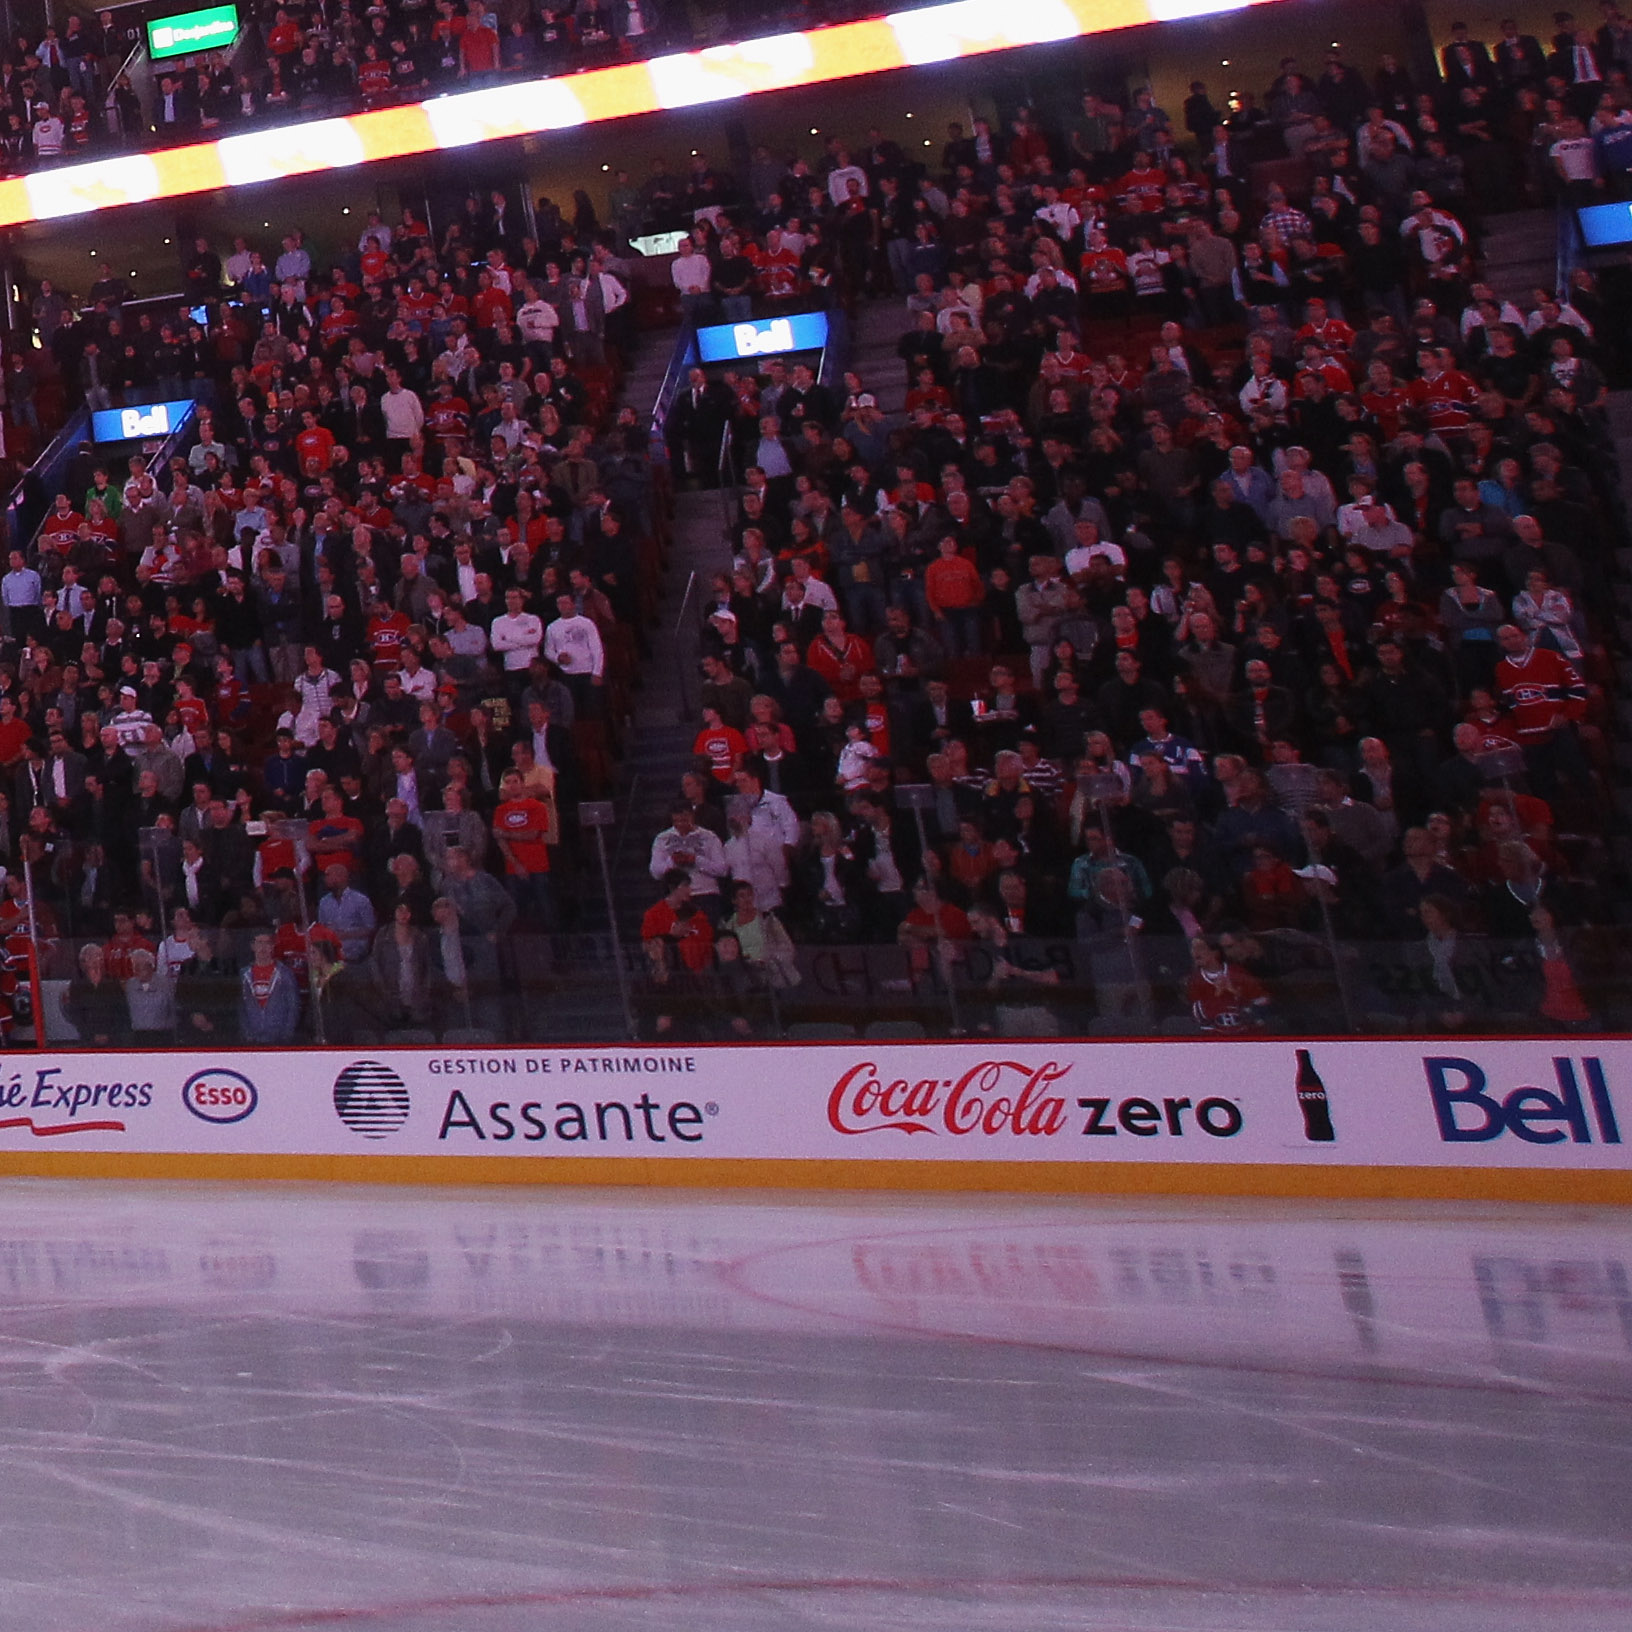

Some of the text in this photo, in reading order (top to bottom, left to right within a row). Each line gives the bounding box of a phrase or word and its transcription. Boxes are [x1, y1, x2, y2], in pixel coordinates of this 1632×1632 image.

[733, 318, 794, 356] Bell
[121, 404, 169, 438] Bell
[428, 1056, 696, 1074] GESTION DE PATRIMOINE
[30, 1068, 153, 1117] Express
[827, 1060, 1244, 1139] Coca-Cola zero
[1298, 1090, 1326, 1101] zero
[1421, 1055, 1622, 1145] Bell
